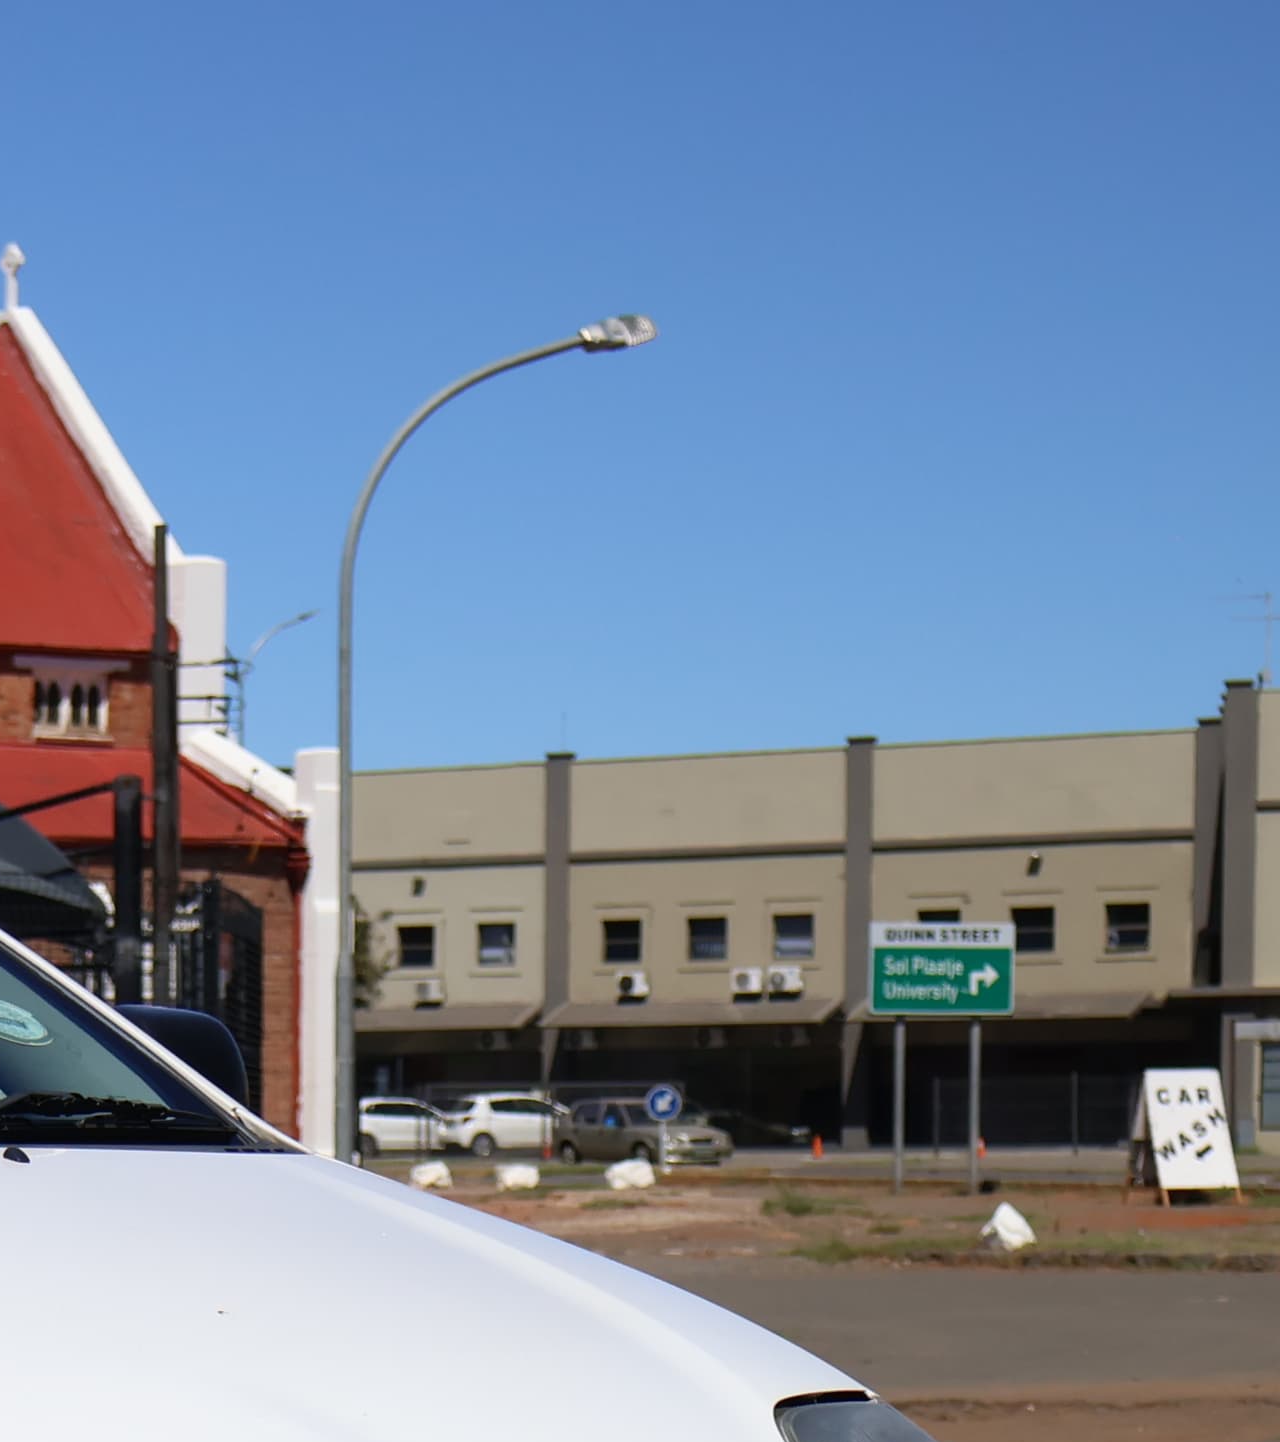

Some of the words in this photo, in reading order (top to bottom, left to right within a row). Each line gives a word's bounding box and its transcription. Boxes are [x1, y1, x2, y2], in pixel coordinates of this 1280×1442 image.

[885, 929, 936, 942] QUINN
[939, 929, 1001, 942] STREET
[883, 955, 910, 977] Sol
[912, 955, 964, 980] Plaatje
[883, 980, 959, 1004] University
[1157, 1088, 1211, 1104] CAR
[1155, 1109, 1225, 1160] WASH
